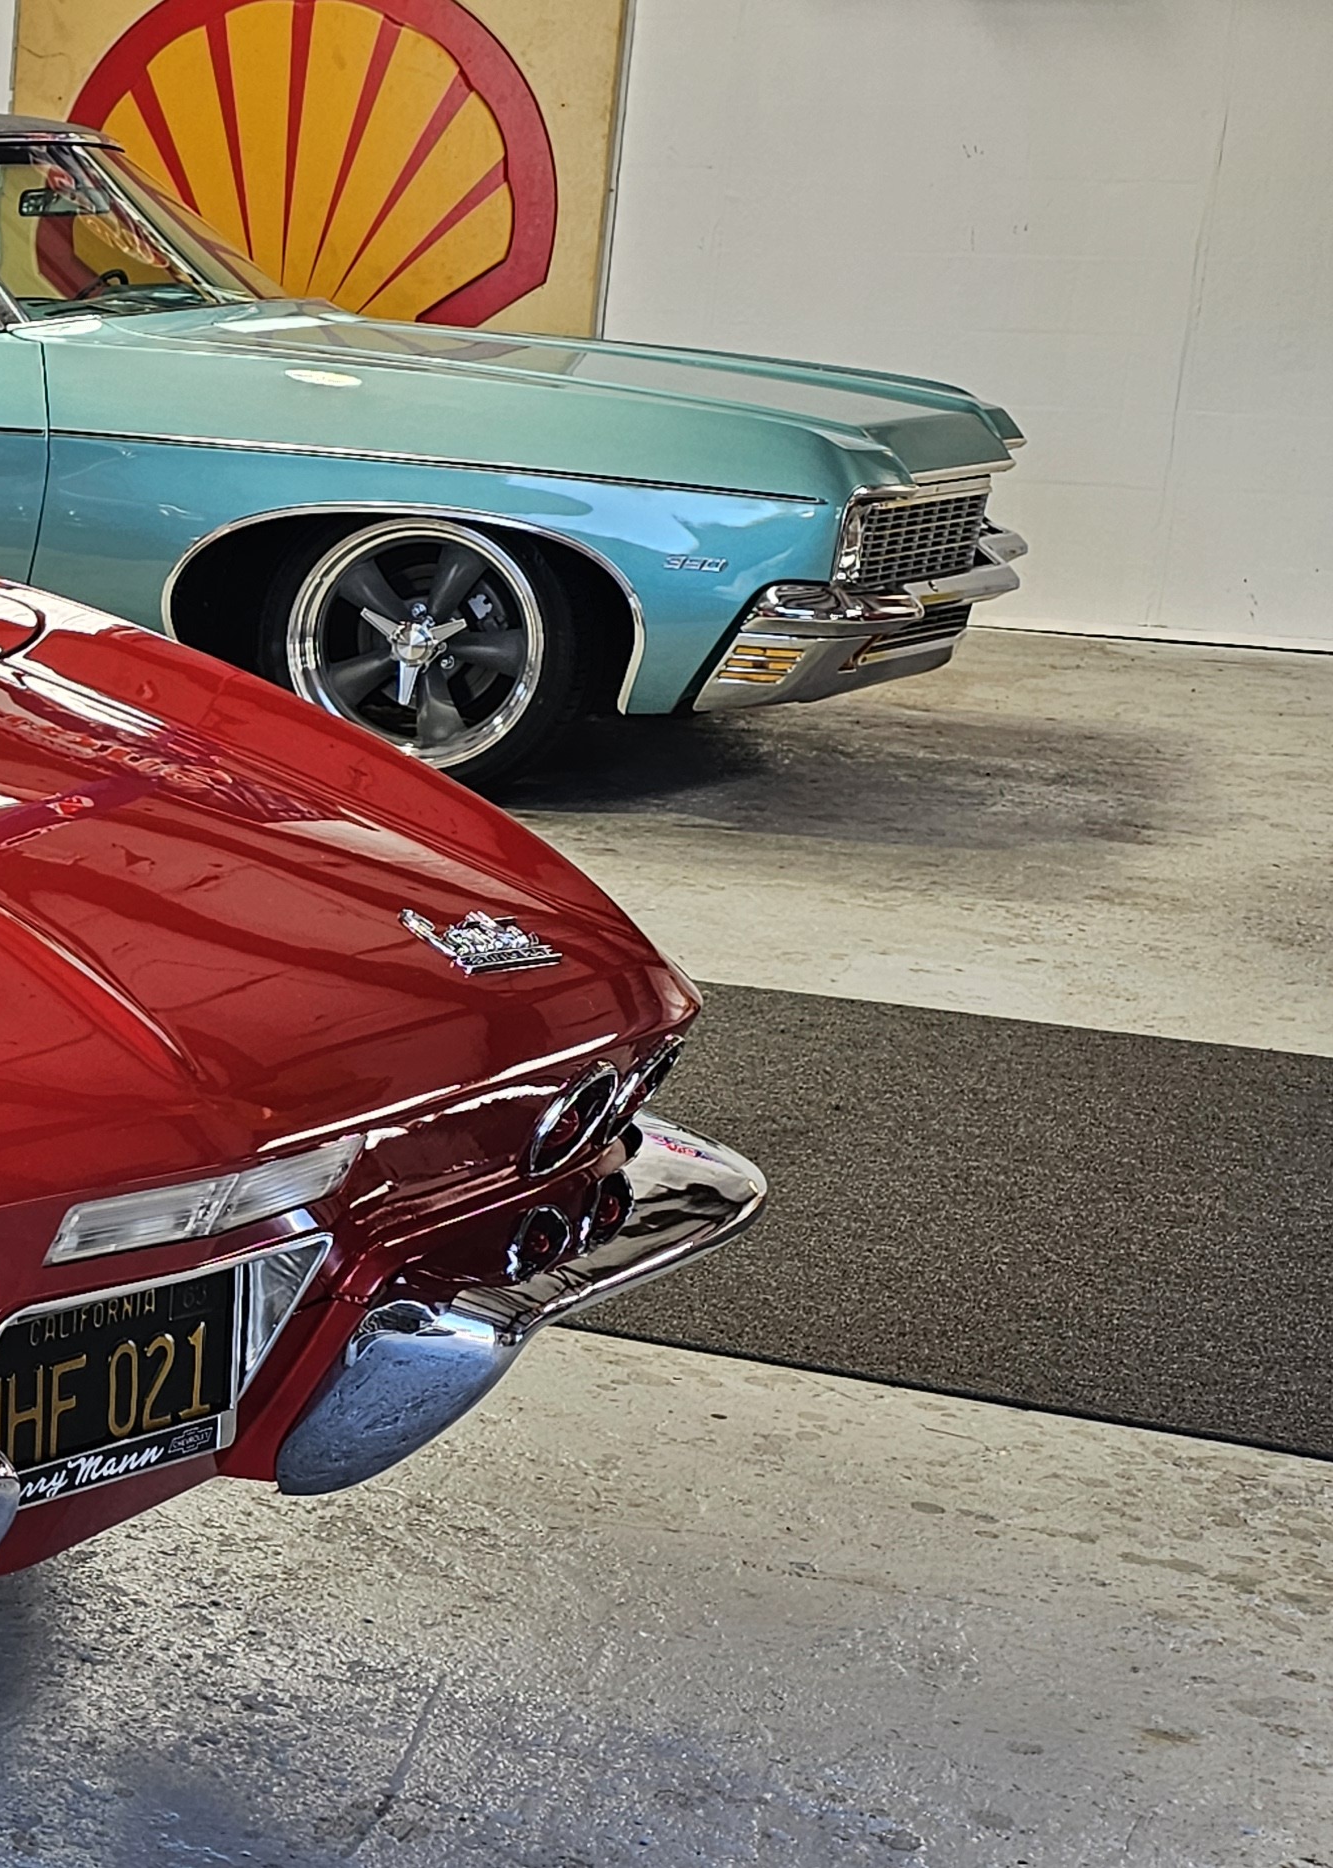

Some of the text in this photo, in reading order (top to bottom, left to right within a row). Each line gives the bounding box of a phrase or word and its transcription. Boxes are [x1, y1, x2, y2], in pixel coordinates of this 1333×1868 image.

[28, 1288, 157, 1346] CALIFORNIA
[107, 1319, 211, 1440] 021
[66, 1444, 165, 1487] Mann
